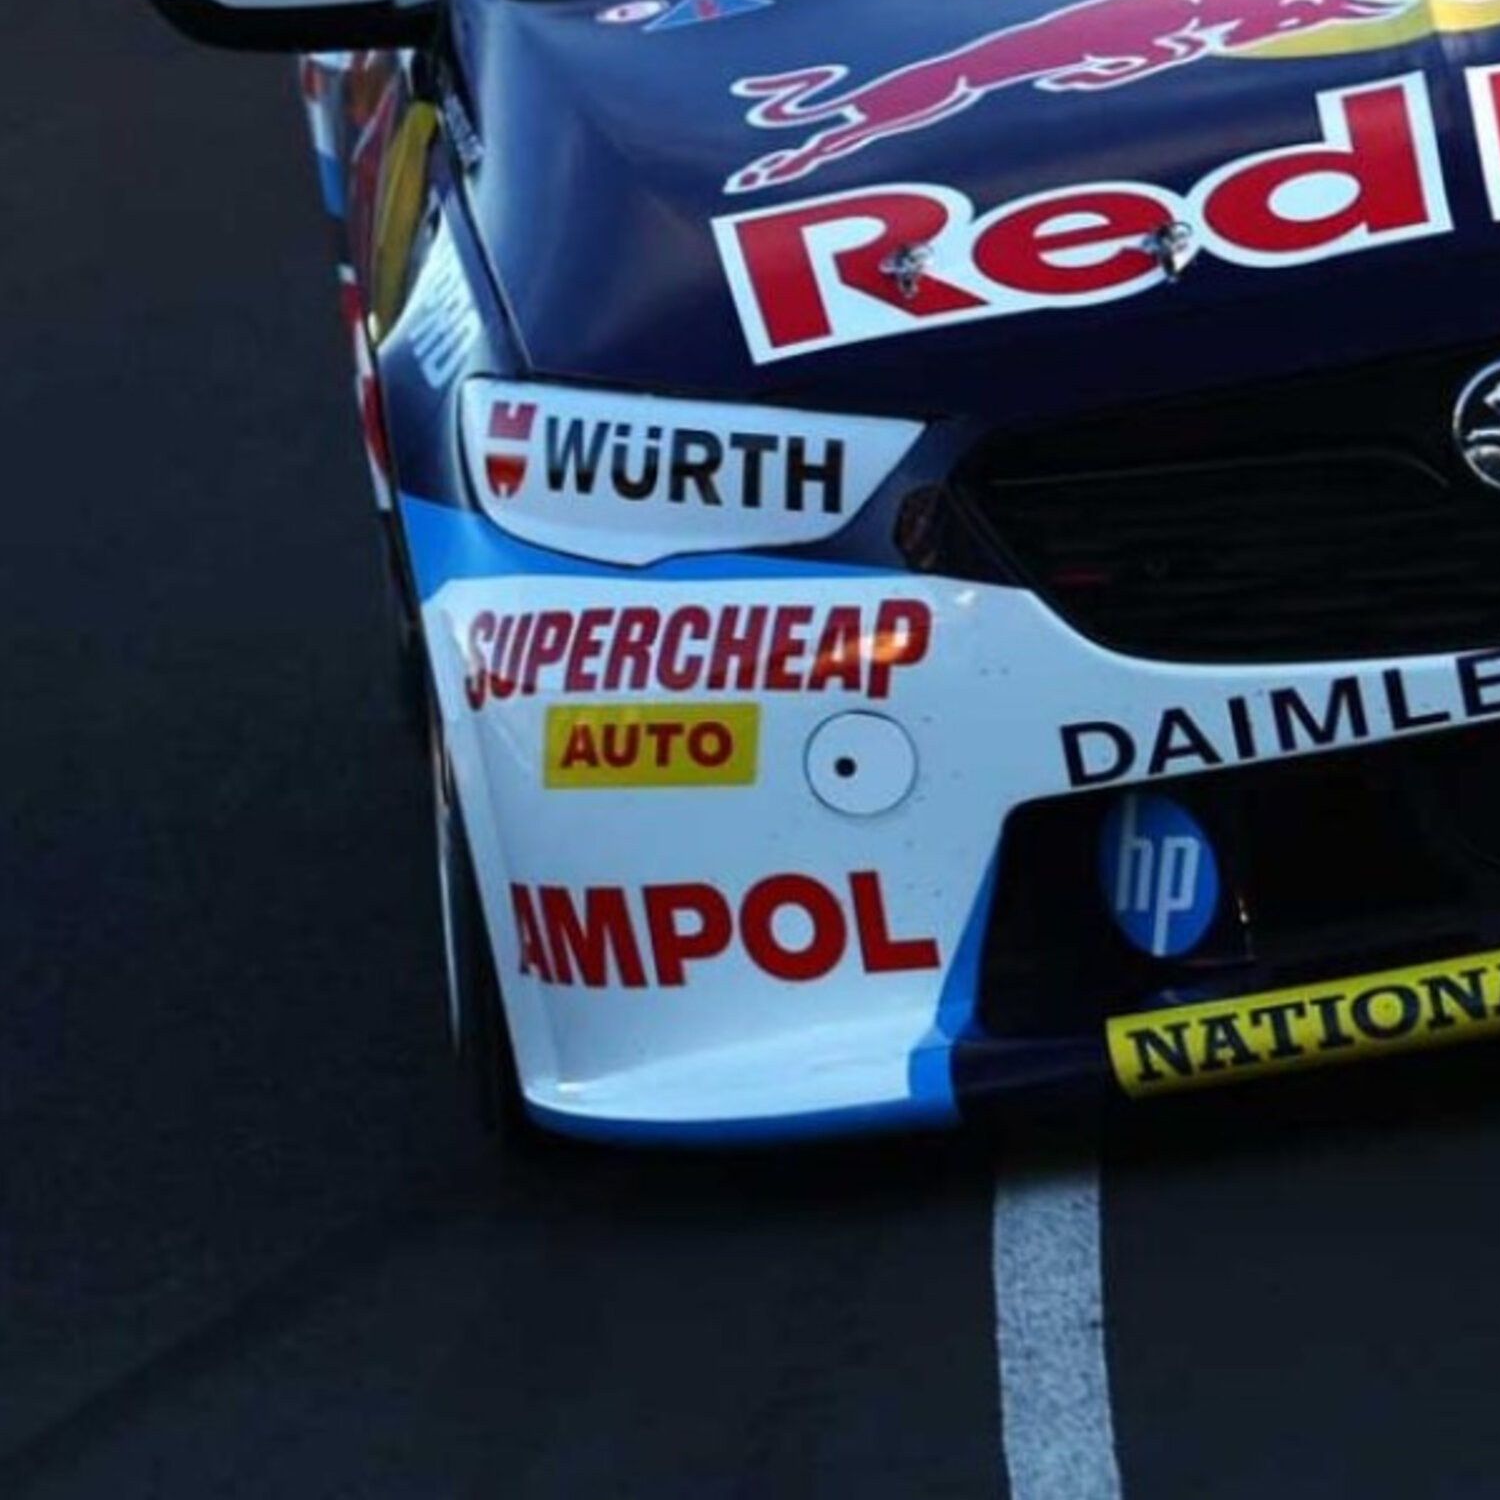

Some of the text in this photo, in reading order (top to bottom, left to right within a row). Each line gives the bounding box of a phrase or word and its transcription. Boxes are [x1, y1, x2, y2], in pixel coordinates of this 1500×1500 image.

[730, 82, 1434, 352] Red
[464, 599, 932, 712] SUPERCHEAP
[559, 722, 735, 769] AUTO
[1115, 797, 1200, 957] hp
